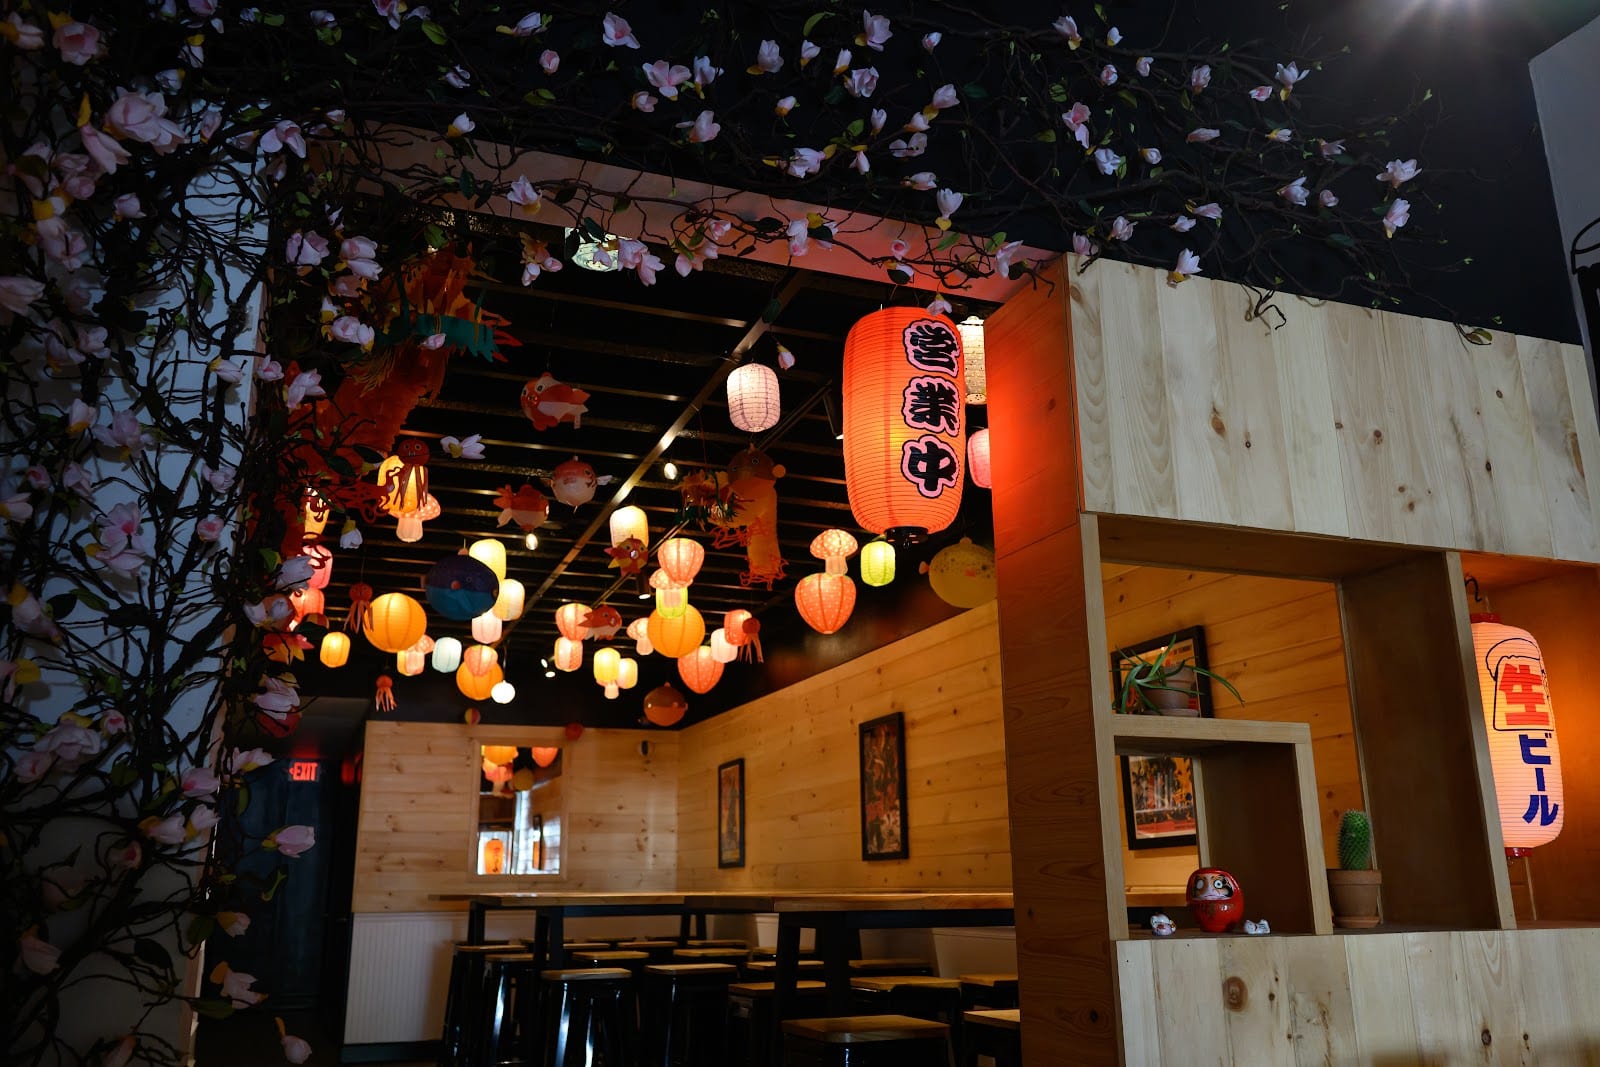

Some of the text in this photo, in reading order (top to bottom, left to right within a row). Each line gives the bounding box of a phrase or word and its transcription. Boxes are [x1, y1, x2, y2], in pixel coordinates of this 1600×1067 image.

[902, 319, 960, 497] 営業中
[293, 761, 318, 782] EXIT
[1498, 663, 1560, 827] 生ビール
